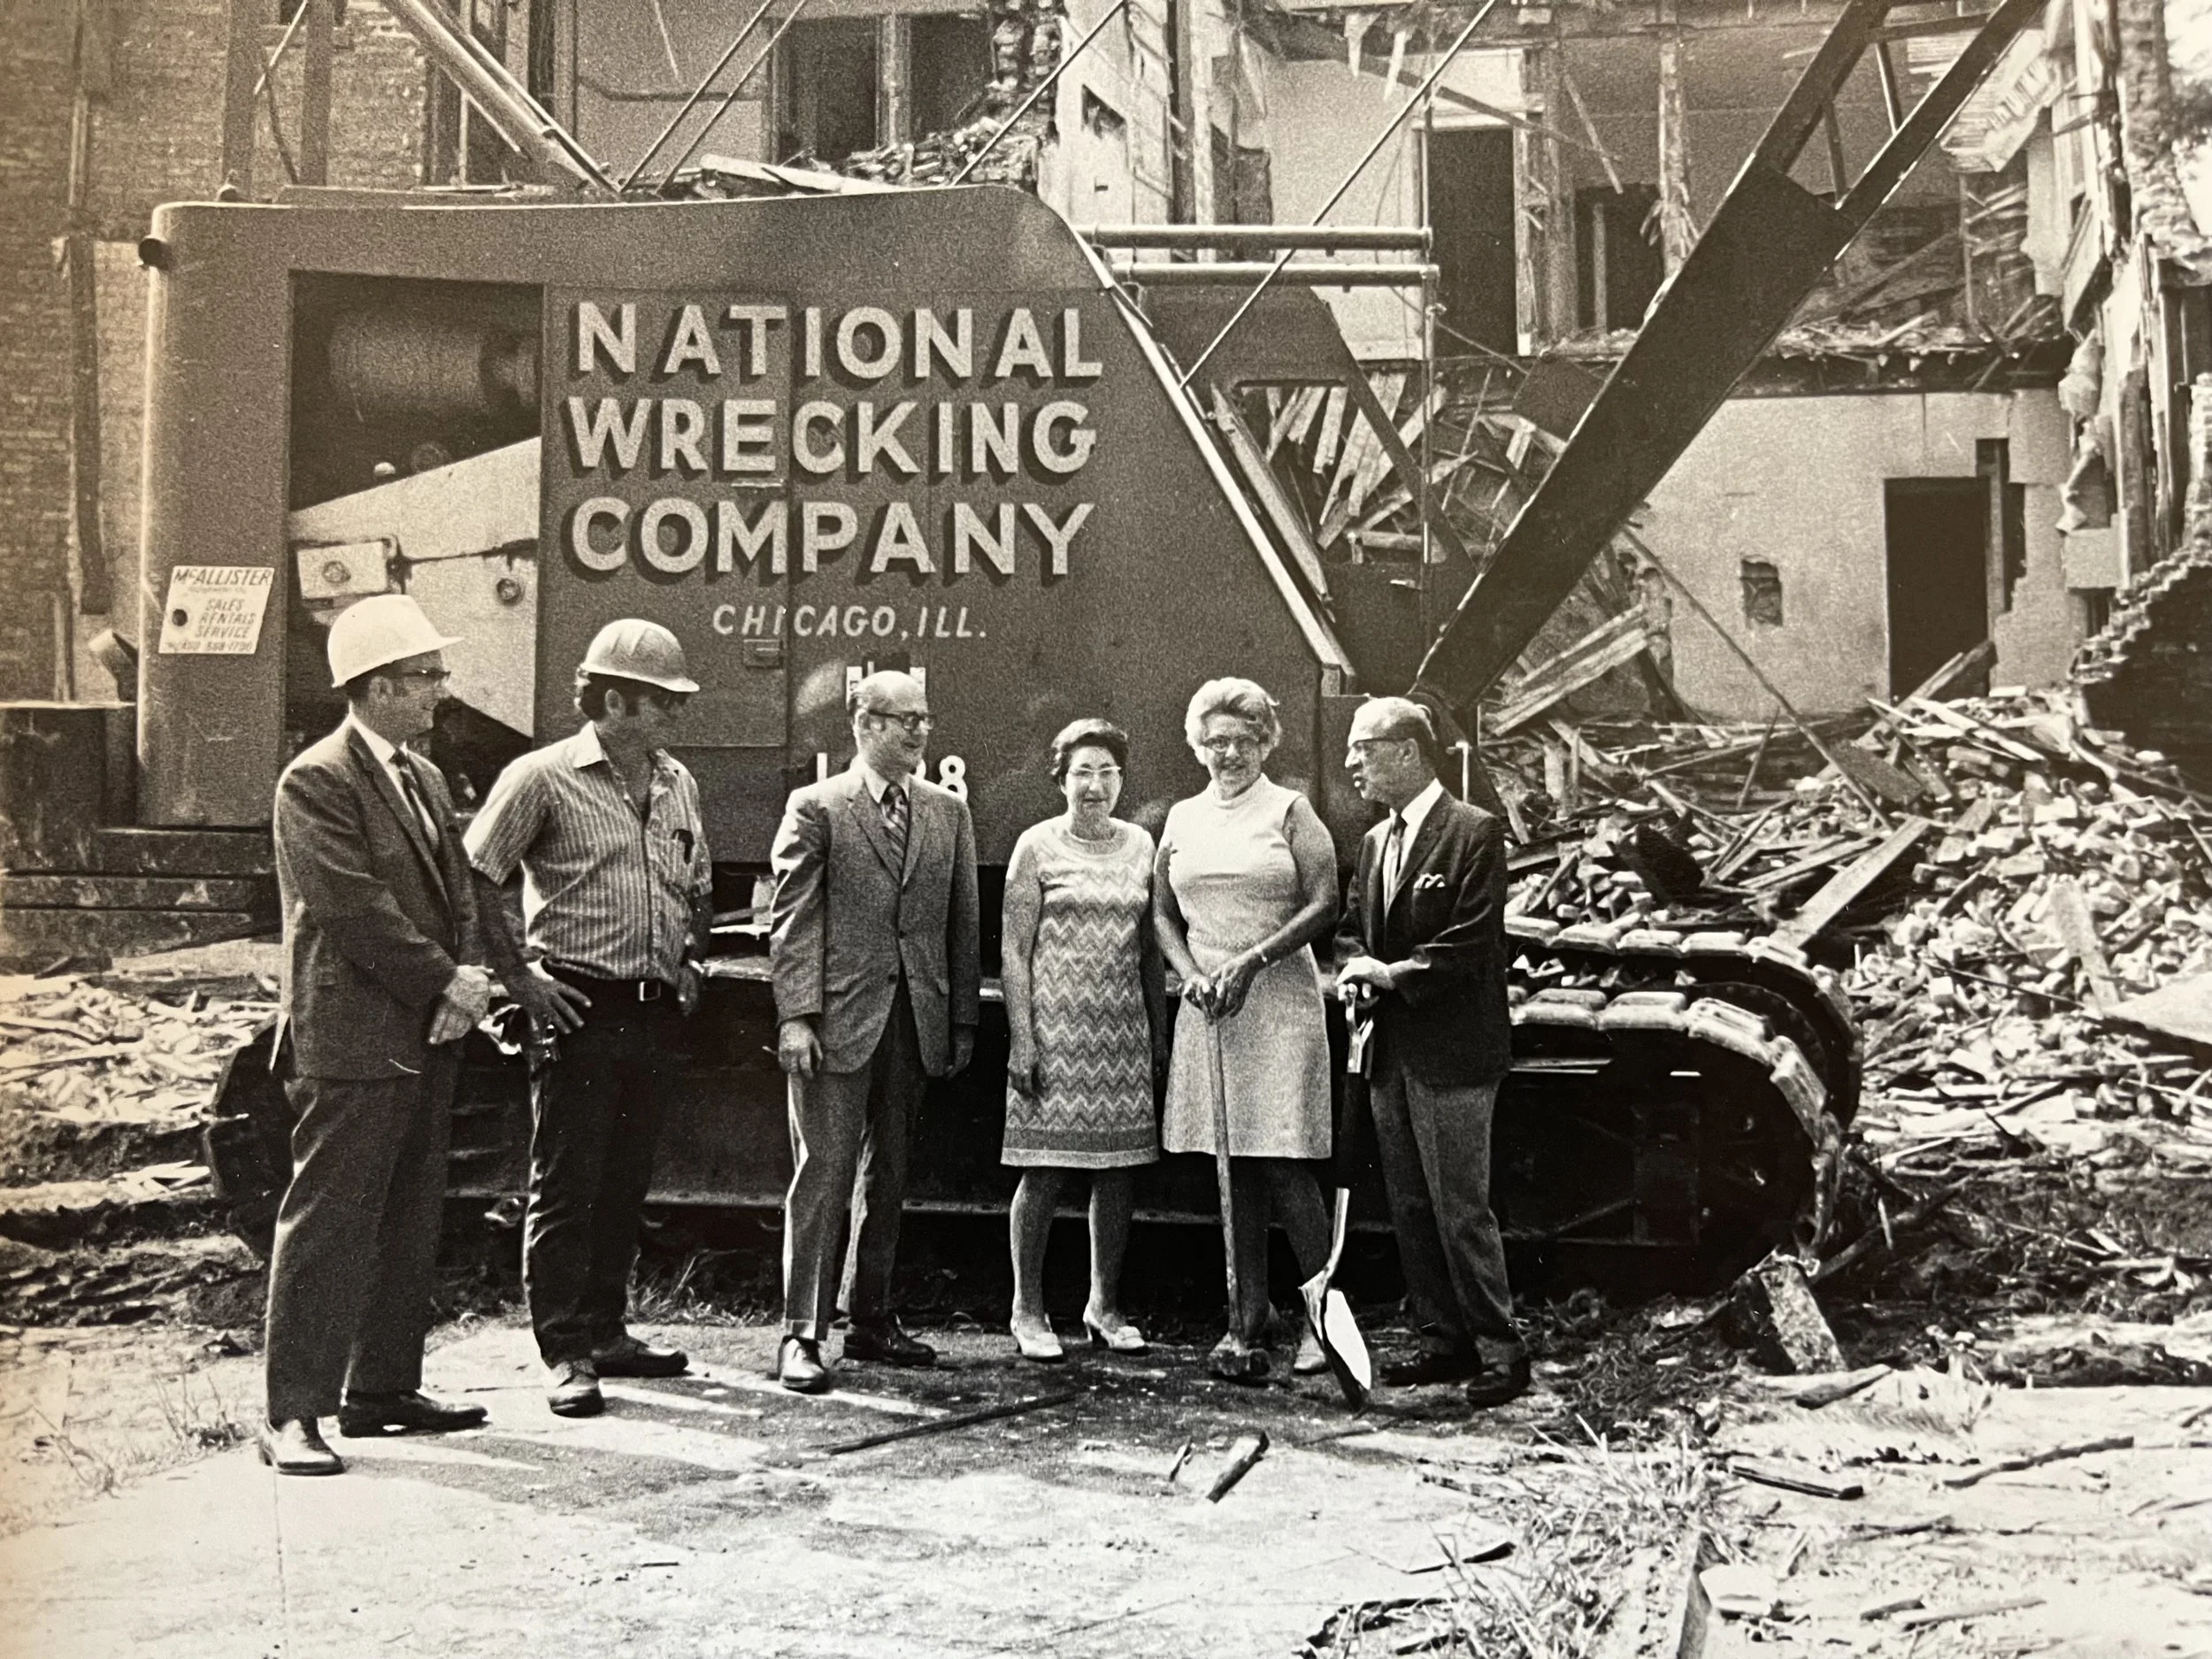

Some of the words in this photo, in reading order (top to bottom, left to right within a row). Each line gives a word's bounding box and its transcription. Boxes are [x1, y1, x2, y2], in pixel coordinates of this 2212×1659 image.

[578, 302, 1103, 380] NATIONAL
[567, 396, 1096, 474] WRECKING
[571, 495, 1095, 575] COMPANY
[199, 612, 256, 626] RENTALS
[205, 598, 244, 611] SALES
[917, 604, 987, 639] ILL.
[196, 626, 250, 638] SERVICE
